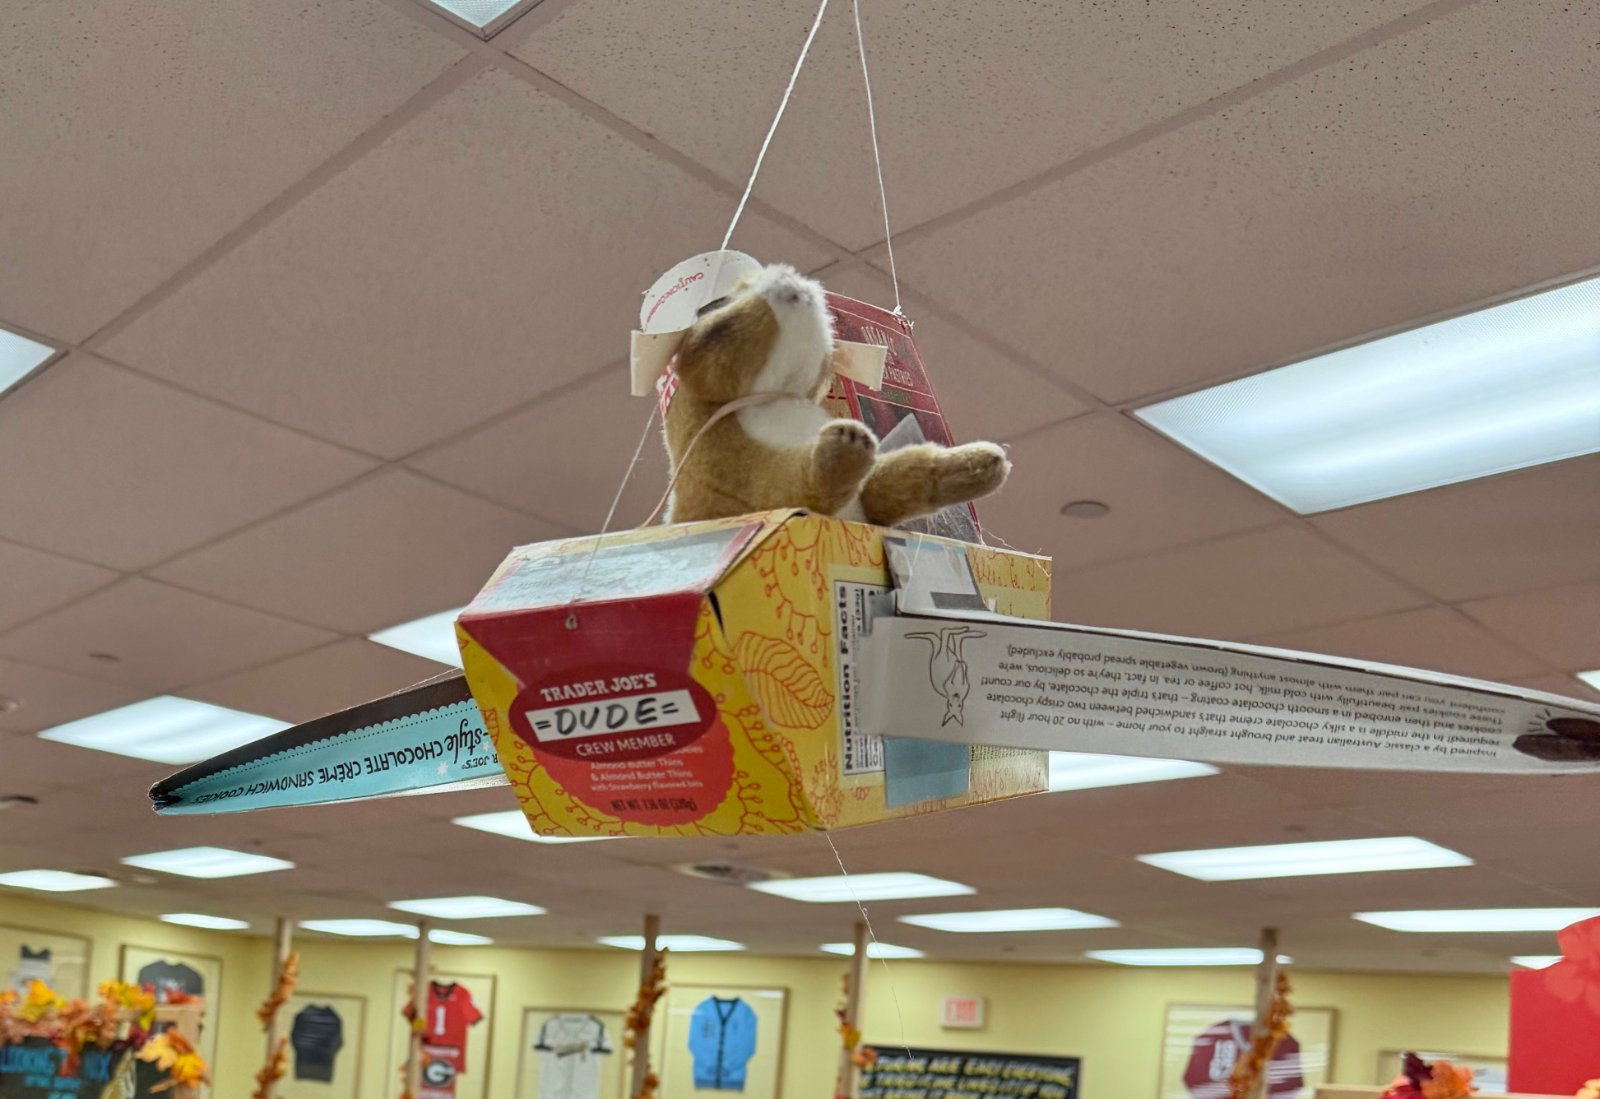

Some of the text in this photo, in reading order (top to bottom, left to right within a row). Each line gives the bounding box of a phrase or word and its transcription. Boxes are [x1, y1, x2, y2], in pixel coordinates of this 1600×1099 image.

[1057, 649, 1101, 661] probably
[1103, 654, 1136, 666] spread
[1025, 663, 1071, 677] delicious,
[1139, 660, 1189, 669] vegetable
[1192, 664, 1228, 676] (brown
[1073, 668, 1085, 676] so
[1087, 669, 1122, 682] they're
[1230, 666, 1276, 680] anything
[839, 586, 853, 770] Nutrition Facts
[981, 676, 1012, 687] count!
[1149, 676, 1159, 684] In
[1280, 676, 1315, 687] almost
[540, 673, 657, 702] TRADER JOE'S
[1015, 680, 1031, 688] our
[1033, 682, 1046, 693] by
[1048, 682, 1099, 696] chocolate,
[1198, 681, 1231, 691] coffee
[1234, 684, 1253, 695] hot
[1318, 682, 1342, 690] with
[1101, 687, 1119, 697] the
[1121, 687, 1148, 699] triple
[1283, 688, 1307, 698] cold
[1345, 686, 1374, 695] them
[1378, 690, 1400, 699] pair
[986, 693, 1034, 707] chocolate
[1036, 696, 1065, 708] crispy
[1151, 691, 1178, 703] that's
[1190, 692, 1229, 705] coating
[1310, 692, 1333, 701] with
[1067, 702, 1086, 710] two
[1232, 698, 1285, 712] chocolate
[1337, 695, 1395, 711] beautifully
[1399, 704, 1420, 713] pair
[1089, 704, 1133, 717] between
[1135, 707, 1196, 720] sandwiched
[1287, 703, 1330, 715] smooth
[1341, 710, 1352, 718] in
[1000, 709, 1025, 723] flight
[1028, 713, 1049, 724] hour
[1052, 715, 1064, 725] 20
[1067, 716, 1080, 725] no
[1199, 713, 1227, 725] that's
[1354, 711, 1401, 722] enrobed
[1083, 717, 1105, 728] with
[1115, 720, 1146, 732] home
[1265, 718, 1319, 731] chocolate
[1322, 722, 1346, 733] silky
[1404, 717, 1430, 727] then
[1434, 720, 1454, 729] and
[1148, 723, 1171, 734] your
[1174, 726, 1185, 735] to
[1188, 726, 1227, 738] straight
[1369, 728, 1409, 738] middle
[1230, 731, 1273, 742] brought
[1275, 734, 1295, 743] and
[1299, 735, 1324, 744] treat
[1411, 732, 1430, 741] the
[1433, 735, 1444, 743] In
[576, 741, 615, 757] CREW
[616, 733, 675, 751] MEMBER
[1327, 737, 1382, 749] Australian
[1384, 743, 1421, 752] classic
[1433, 745, 1447, 754] by
[1450, 747, 1497, 757] Inspired
[364, 740, 443, 774] CHOCOLATE
[601, 771, 637, 781] Almond
